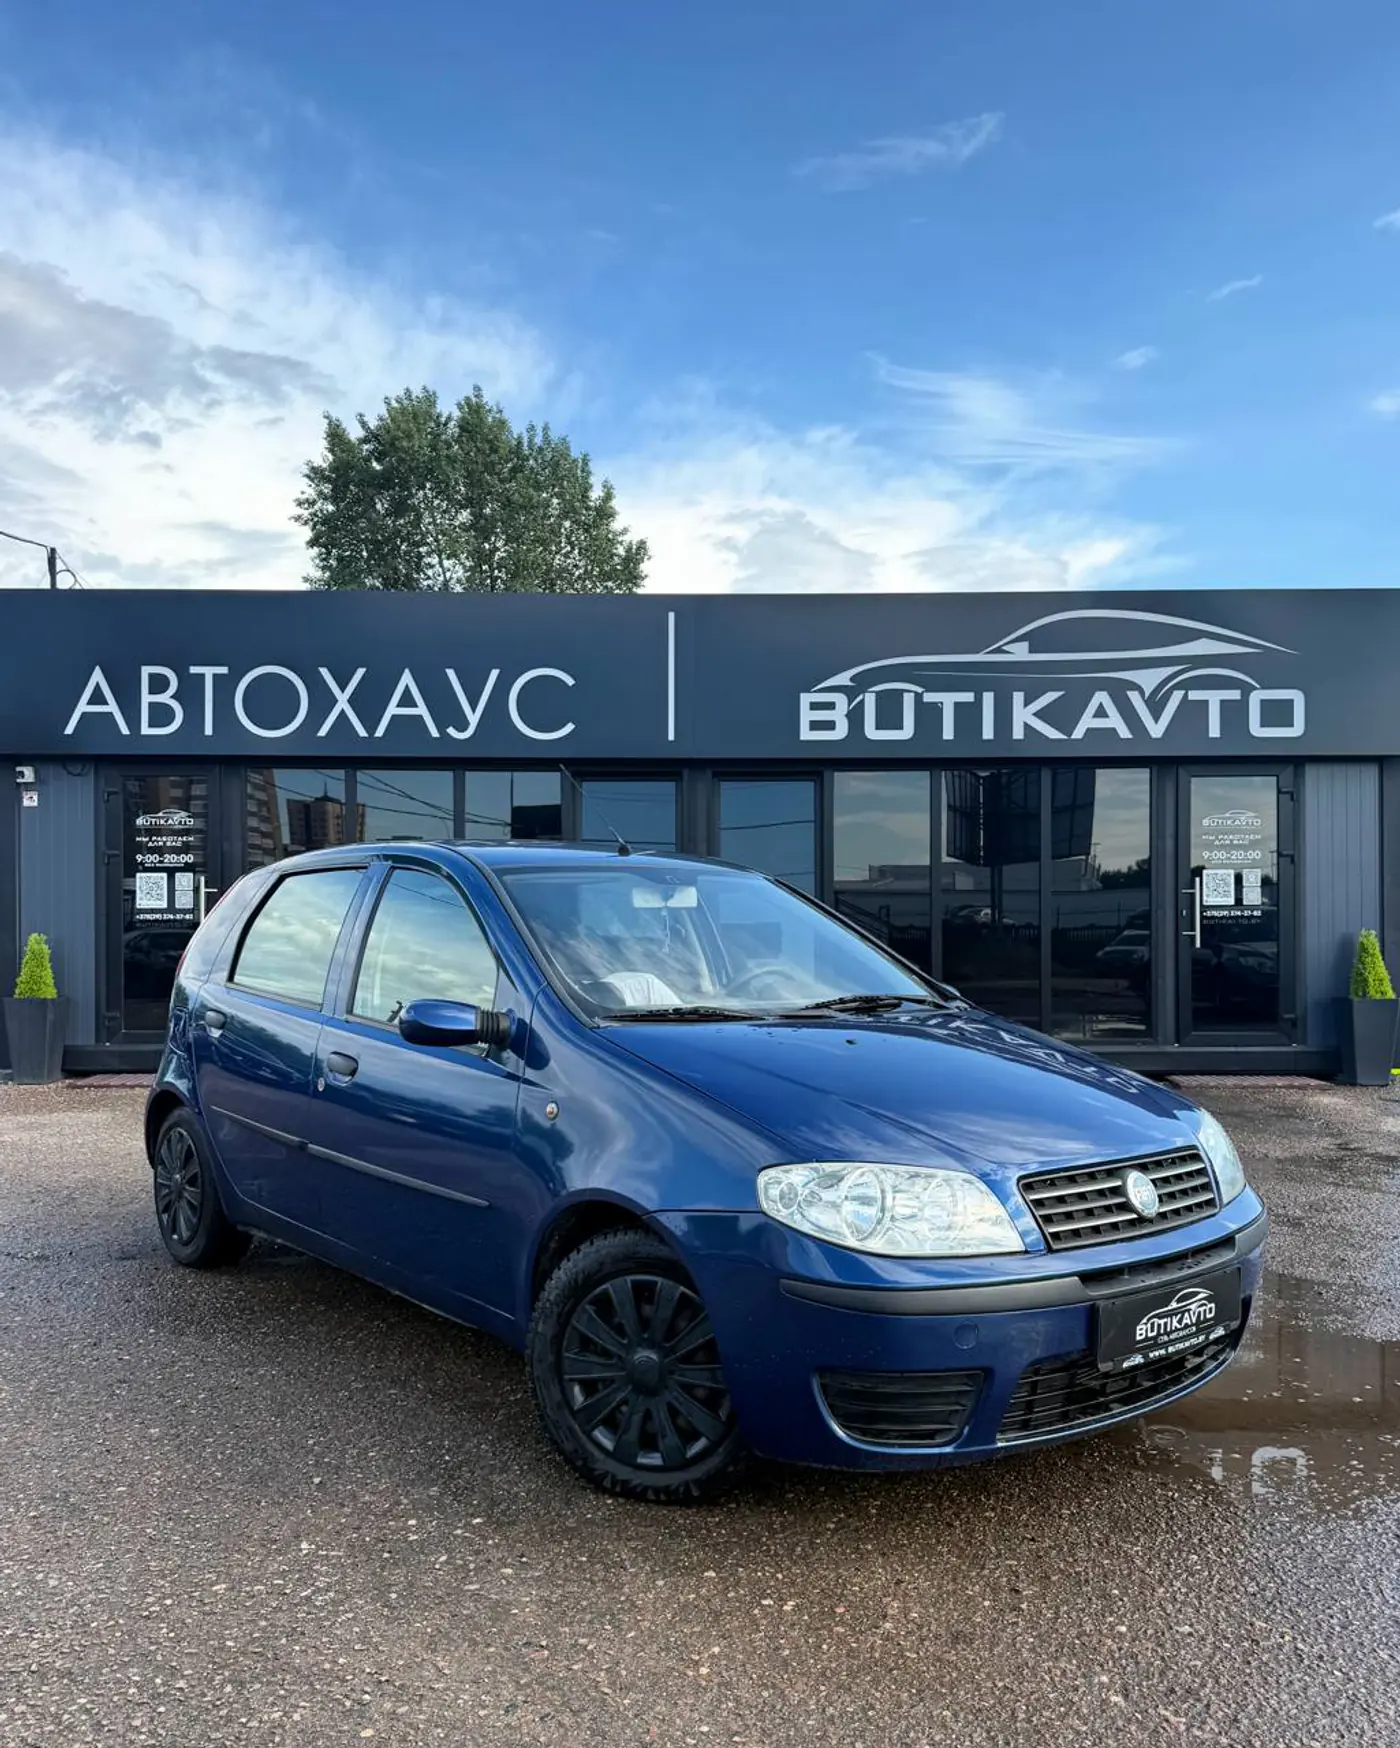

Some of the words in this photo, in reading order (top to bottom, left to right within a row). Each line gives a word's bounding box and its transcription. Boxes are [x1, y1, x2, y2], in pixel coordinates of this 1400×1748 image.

[64, 665, 576, 740] АВТОХАУС
[799, 688, 1306, 741] BUTIKAVTO
[136, 818, 194, 826] BUTIKAVTO
[136, 853, 194, 863] 9:00-20:00
[1202, 850, 1261, 860] 9:00-20:00
[1136, 1303, 1215, 1340] BUTIKAVTO
